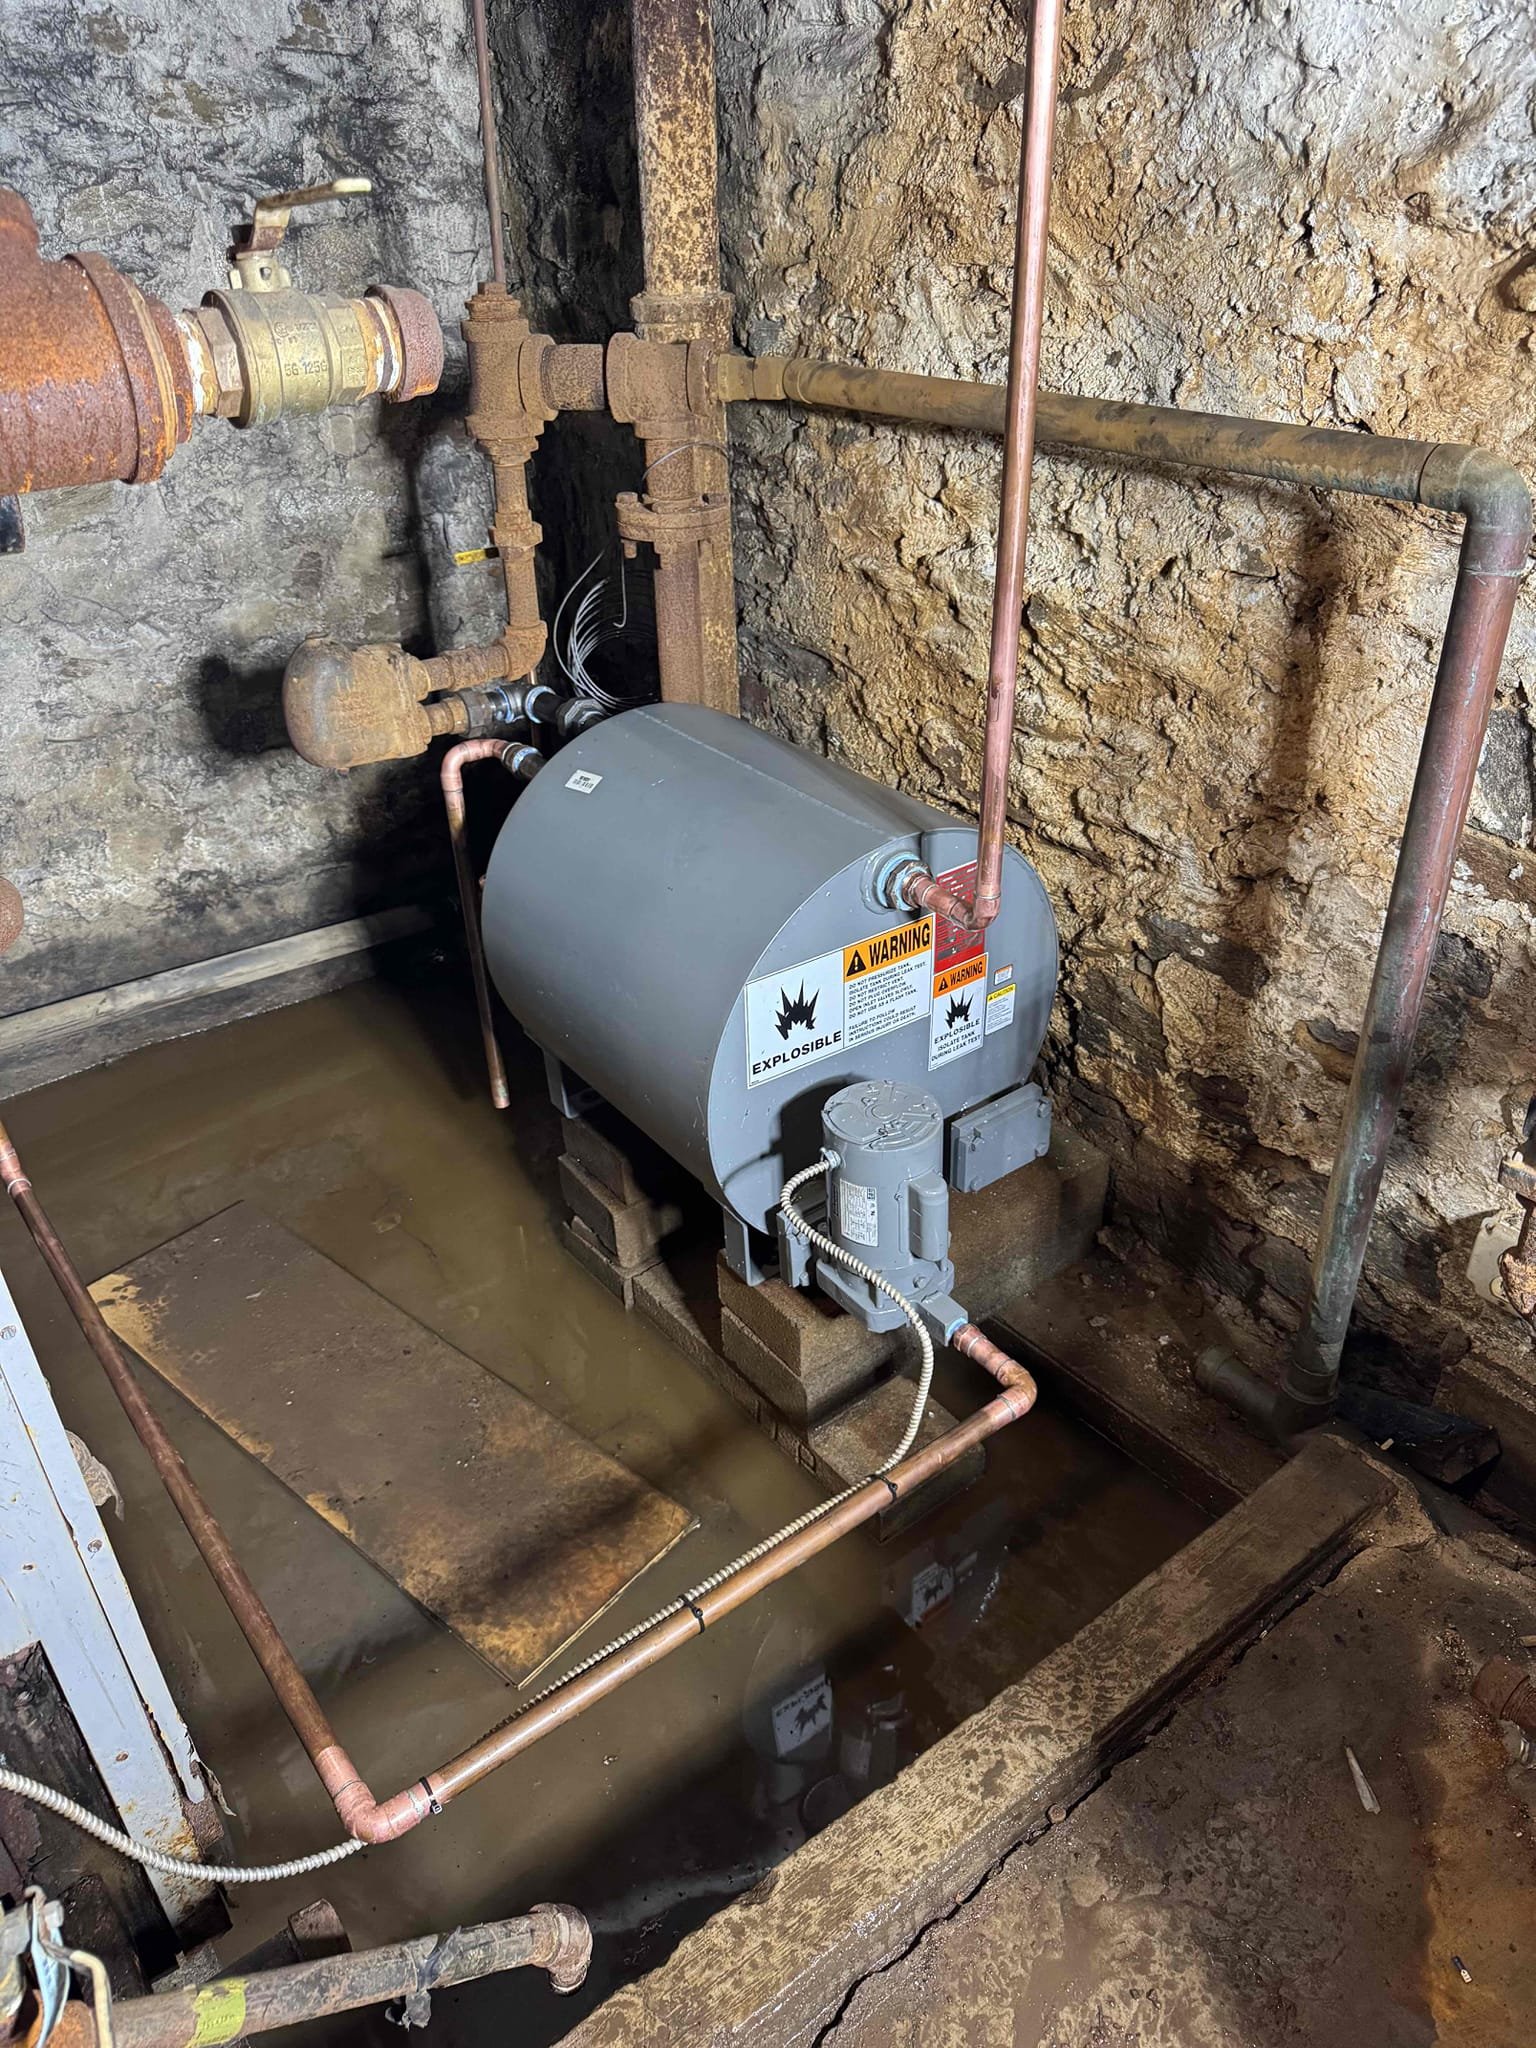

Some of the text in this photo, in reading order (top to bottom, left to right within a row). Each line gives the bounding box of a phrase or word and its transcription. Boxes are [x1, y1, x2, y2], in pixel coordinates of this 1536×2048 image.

[869, 923, 931, 967] WARNING
[849, 984, 867, 995] ISOLATE
[870, 979, 881, 987] TANK
[883, 972, 899, 982] DURING
[901, 966, 912, 974] LEAK
[868, 967, 896, 982] PRESSURIZE
[950, 961, 983, 986] WARNING
[868, 981, 890, 993] RESTRICT
[868, 991, 879, 999] PLUG
[890, 993, 903, 1002] FLASH
[849, 1004, 861, 1013] OPEN
[863, 998, 876, 1007] INLET
[877, 992, 893, 1001] VALVES
[849, 1019, 867, 1030] FAILURE
[876, 1008, 895, 1019] FOLLOW
[849, 1005, 915, 1036] INSTRUCTIONS COULD RESULT
[855, 1028, 874, 1039] SERIOUS
[876, 1021, 891, 1031] INJURY
[934, 1018, 980, 1044] EXPLOSIBLE
[938, 1031, 975, 1051] ISOLATE TANK
[752, 1030, 842, 1075] EXPLOSIBLE
[931, 1034, 981, 1062] DURING LEAK TEST
